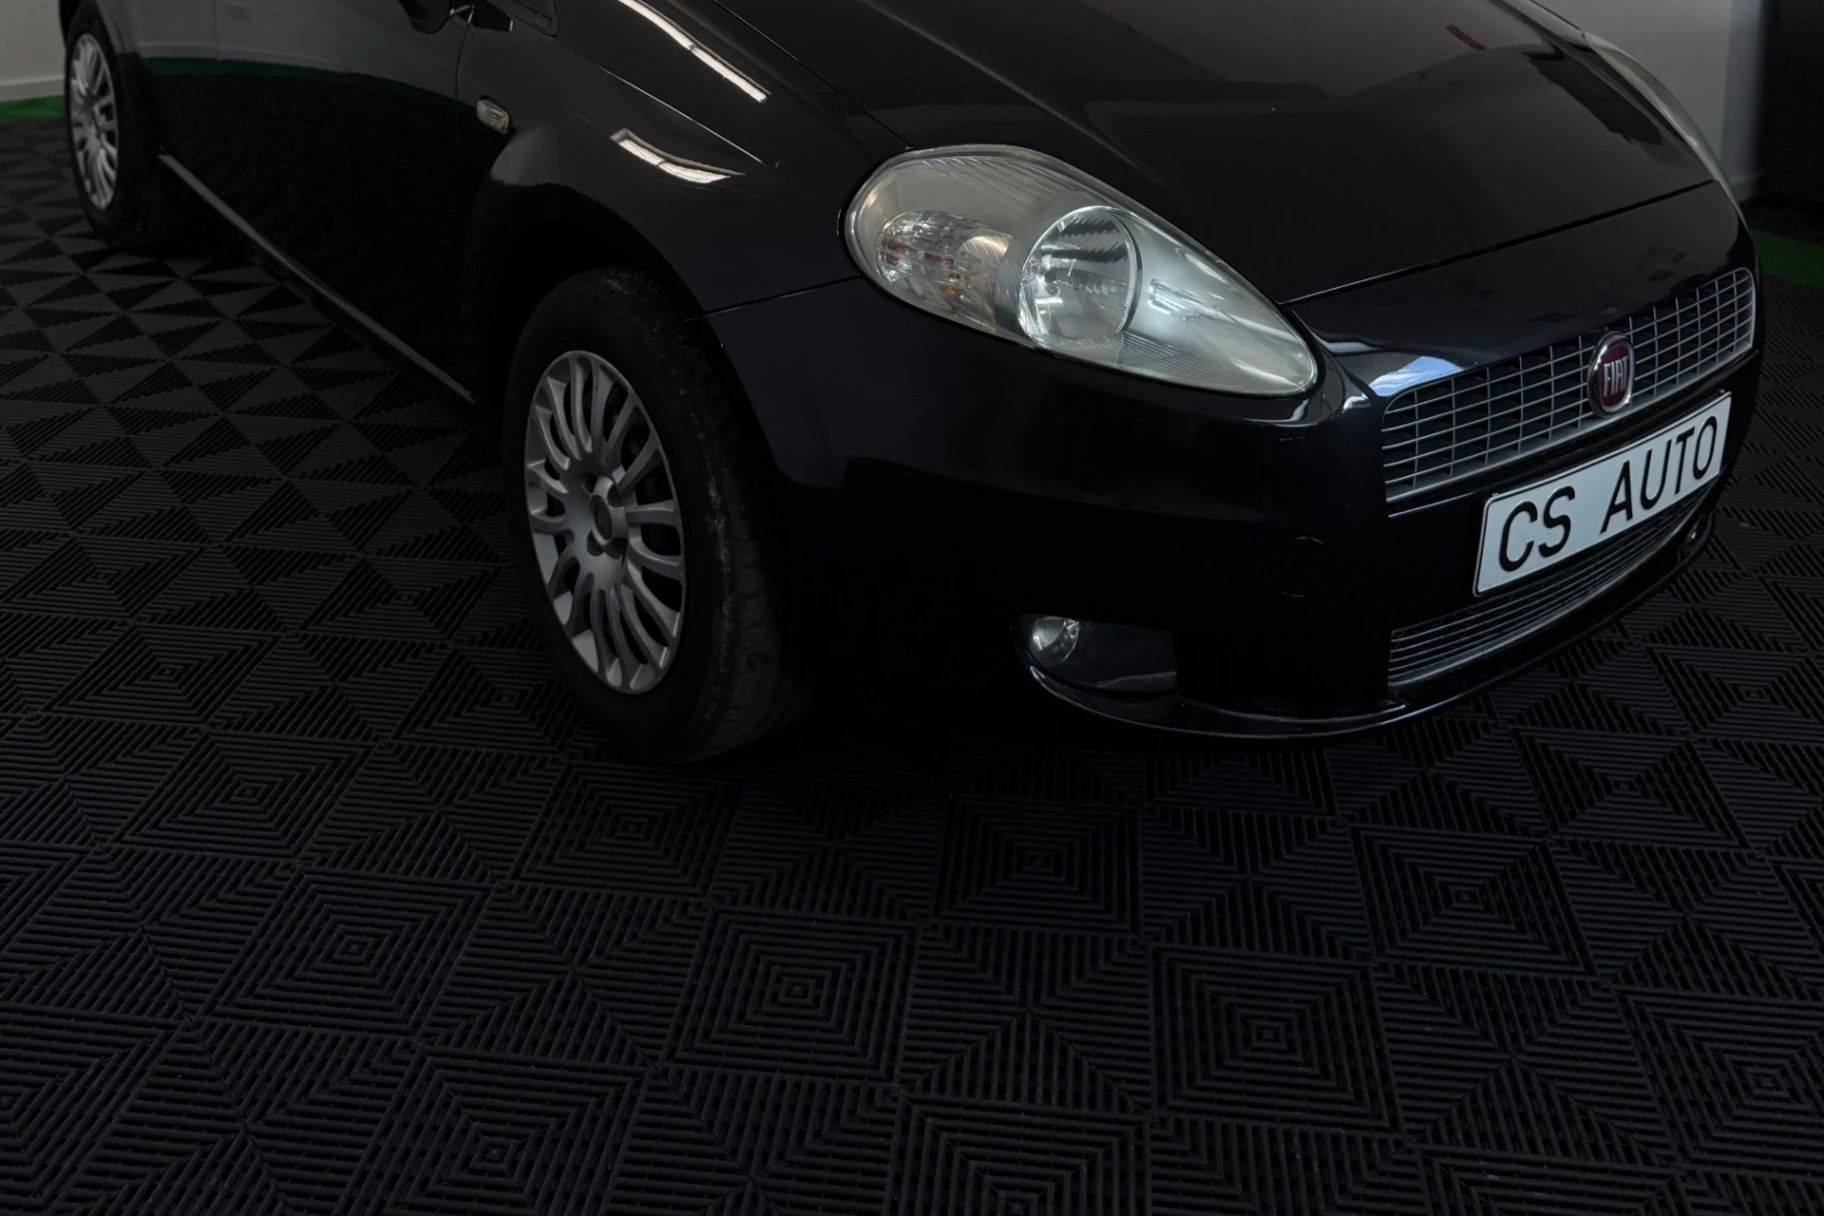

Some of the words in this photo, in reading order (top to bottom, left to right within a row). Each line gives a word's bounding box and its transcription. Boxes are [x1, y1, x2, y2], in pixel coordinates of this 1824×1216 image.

[1603, 355, 1629, 397] FIAT
[1499, 486, 1575, 572] CS
[1600, 415, 1717, 534] AUTO
